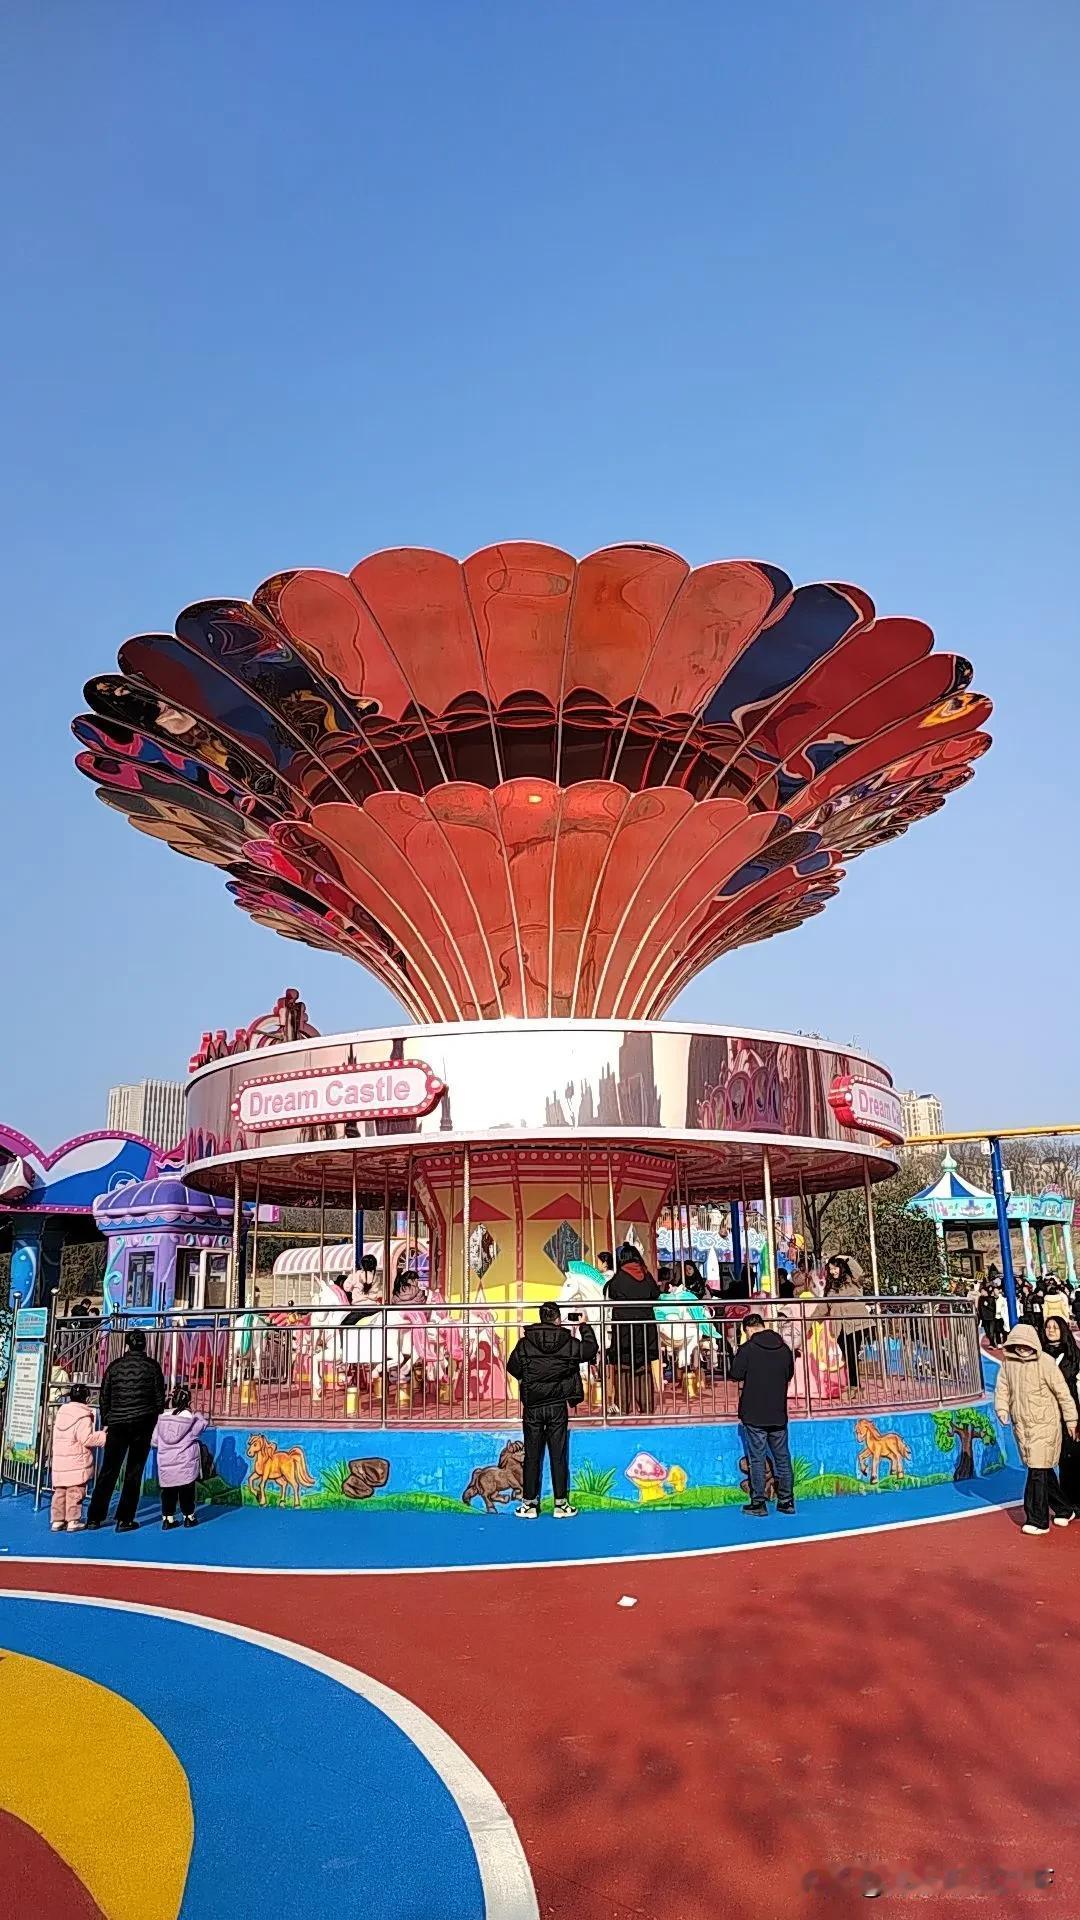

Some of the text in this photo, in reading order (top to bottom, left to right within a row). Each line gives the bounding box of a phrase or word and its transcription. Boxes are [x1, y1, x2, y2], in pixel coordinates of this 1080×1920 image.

[249, 1075, 411, 1116] Dream Castle
[859, 1089, 891, 1120] Dream
